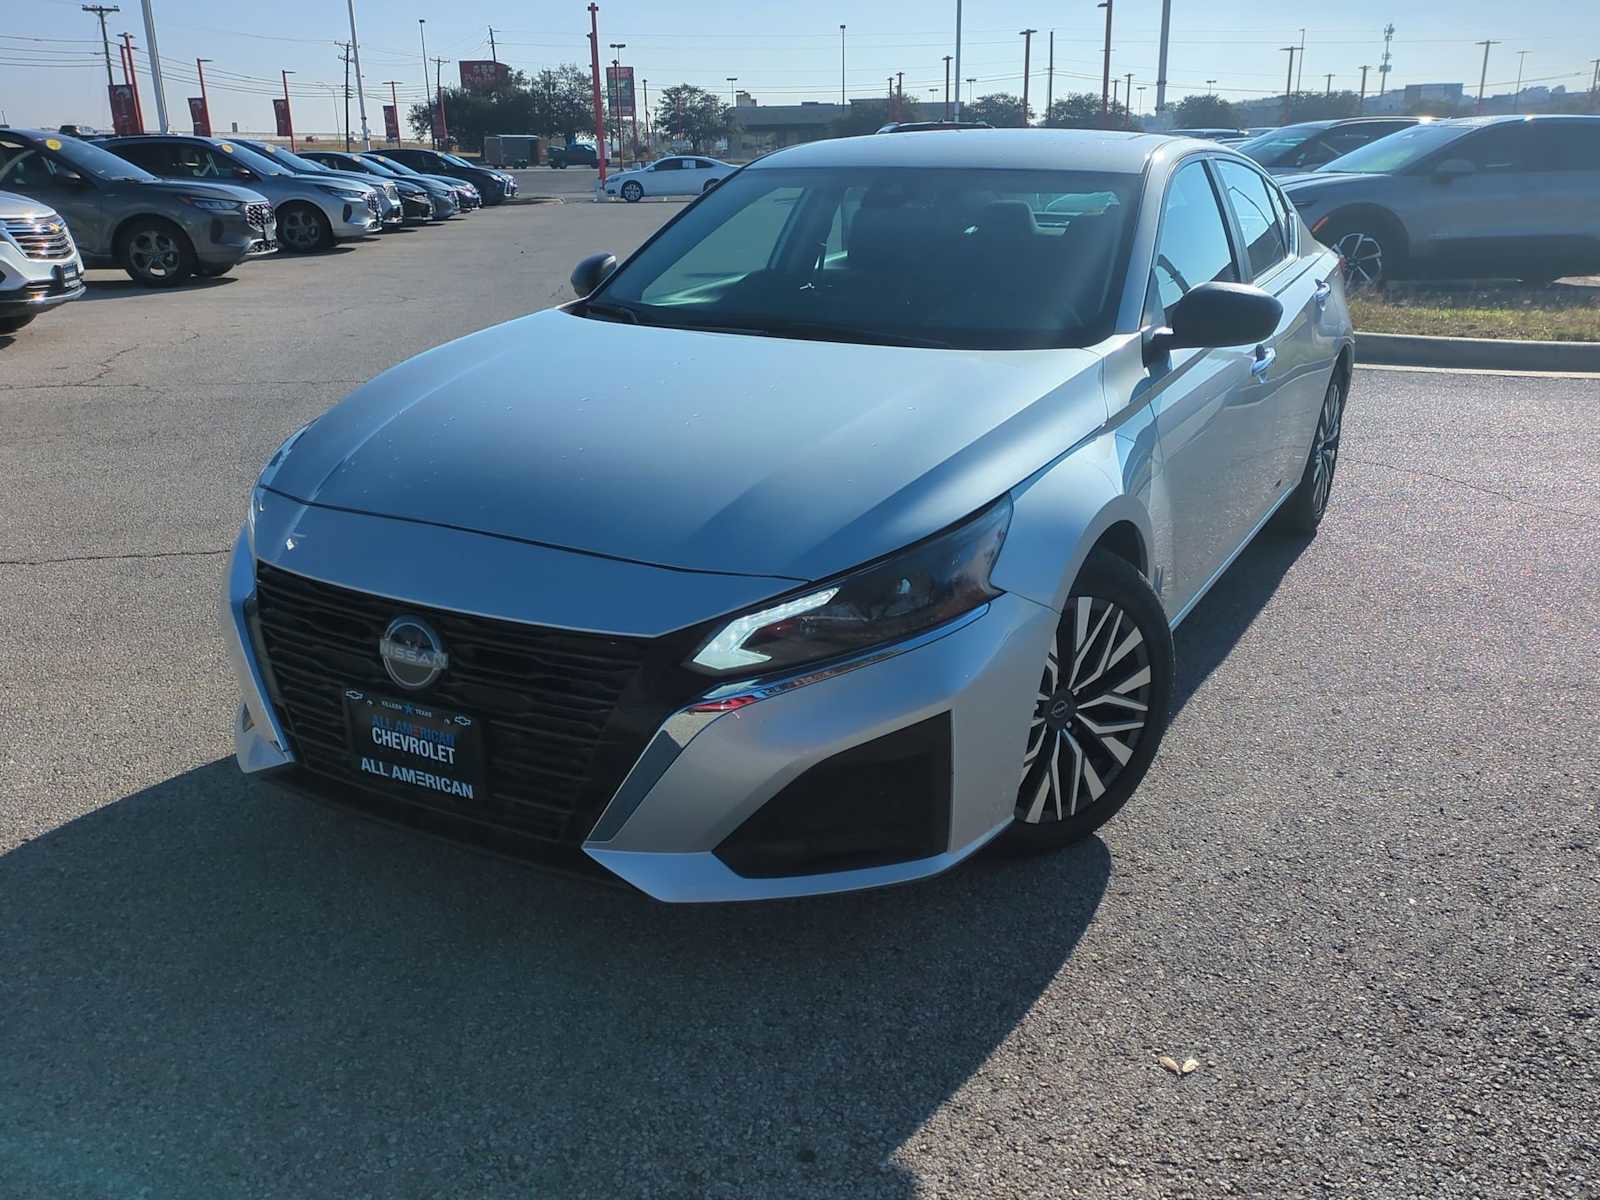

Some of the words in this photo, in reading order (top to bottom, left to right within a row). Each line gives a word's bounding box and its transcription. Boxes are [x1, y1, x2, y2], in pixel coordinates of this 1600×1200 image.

[380, 640, 448, 665] NISSAN
[415, 709, 432, 718] TEXAS
[371, 714, 390, 730] ALL
[395, 719, 456, 747] AMERICAN
[372, 727, 455, 764] CHEVROLET
[361, 757, 389, 777] ALL
[392, 765, 474, 799] AMERICAN
